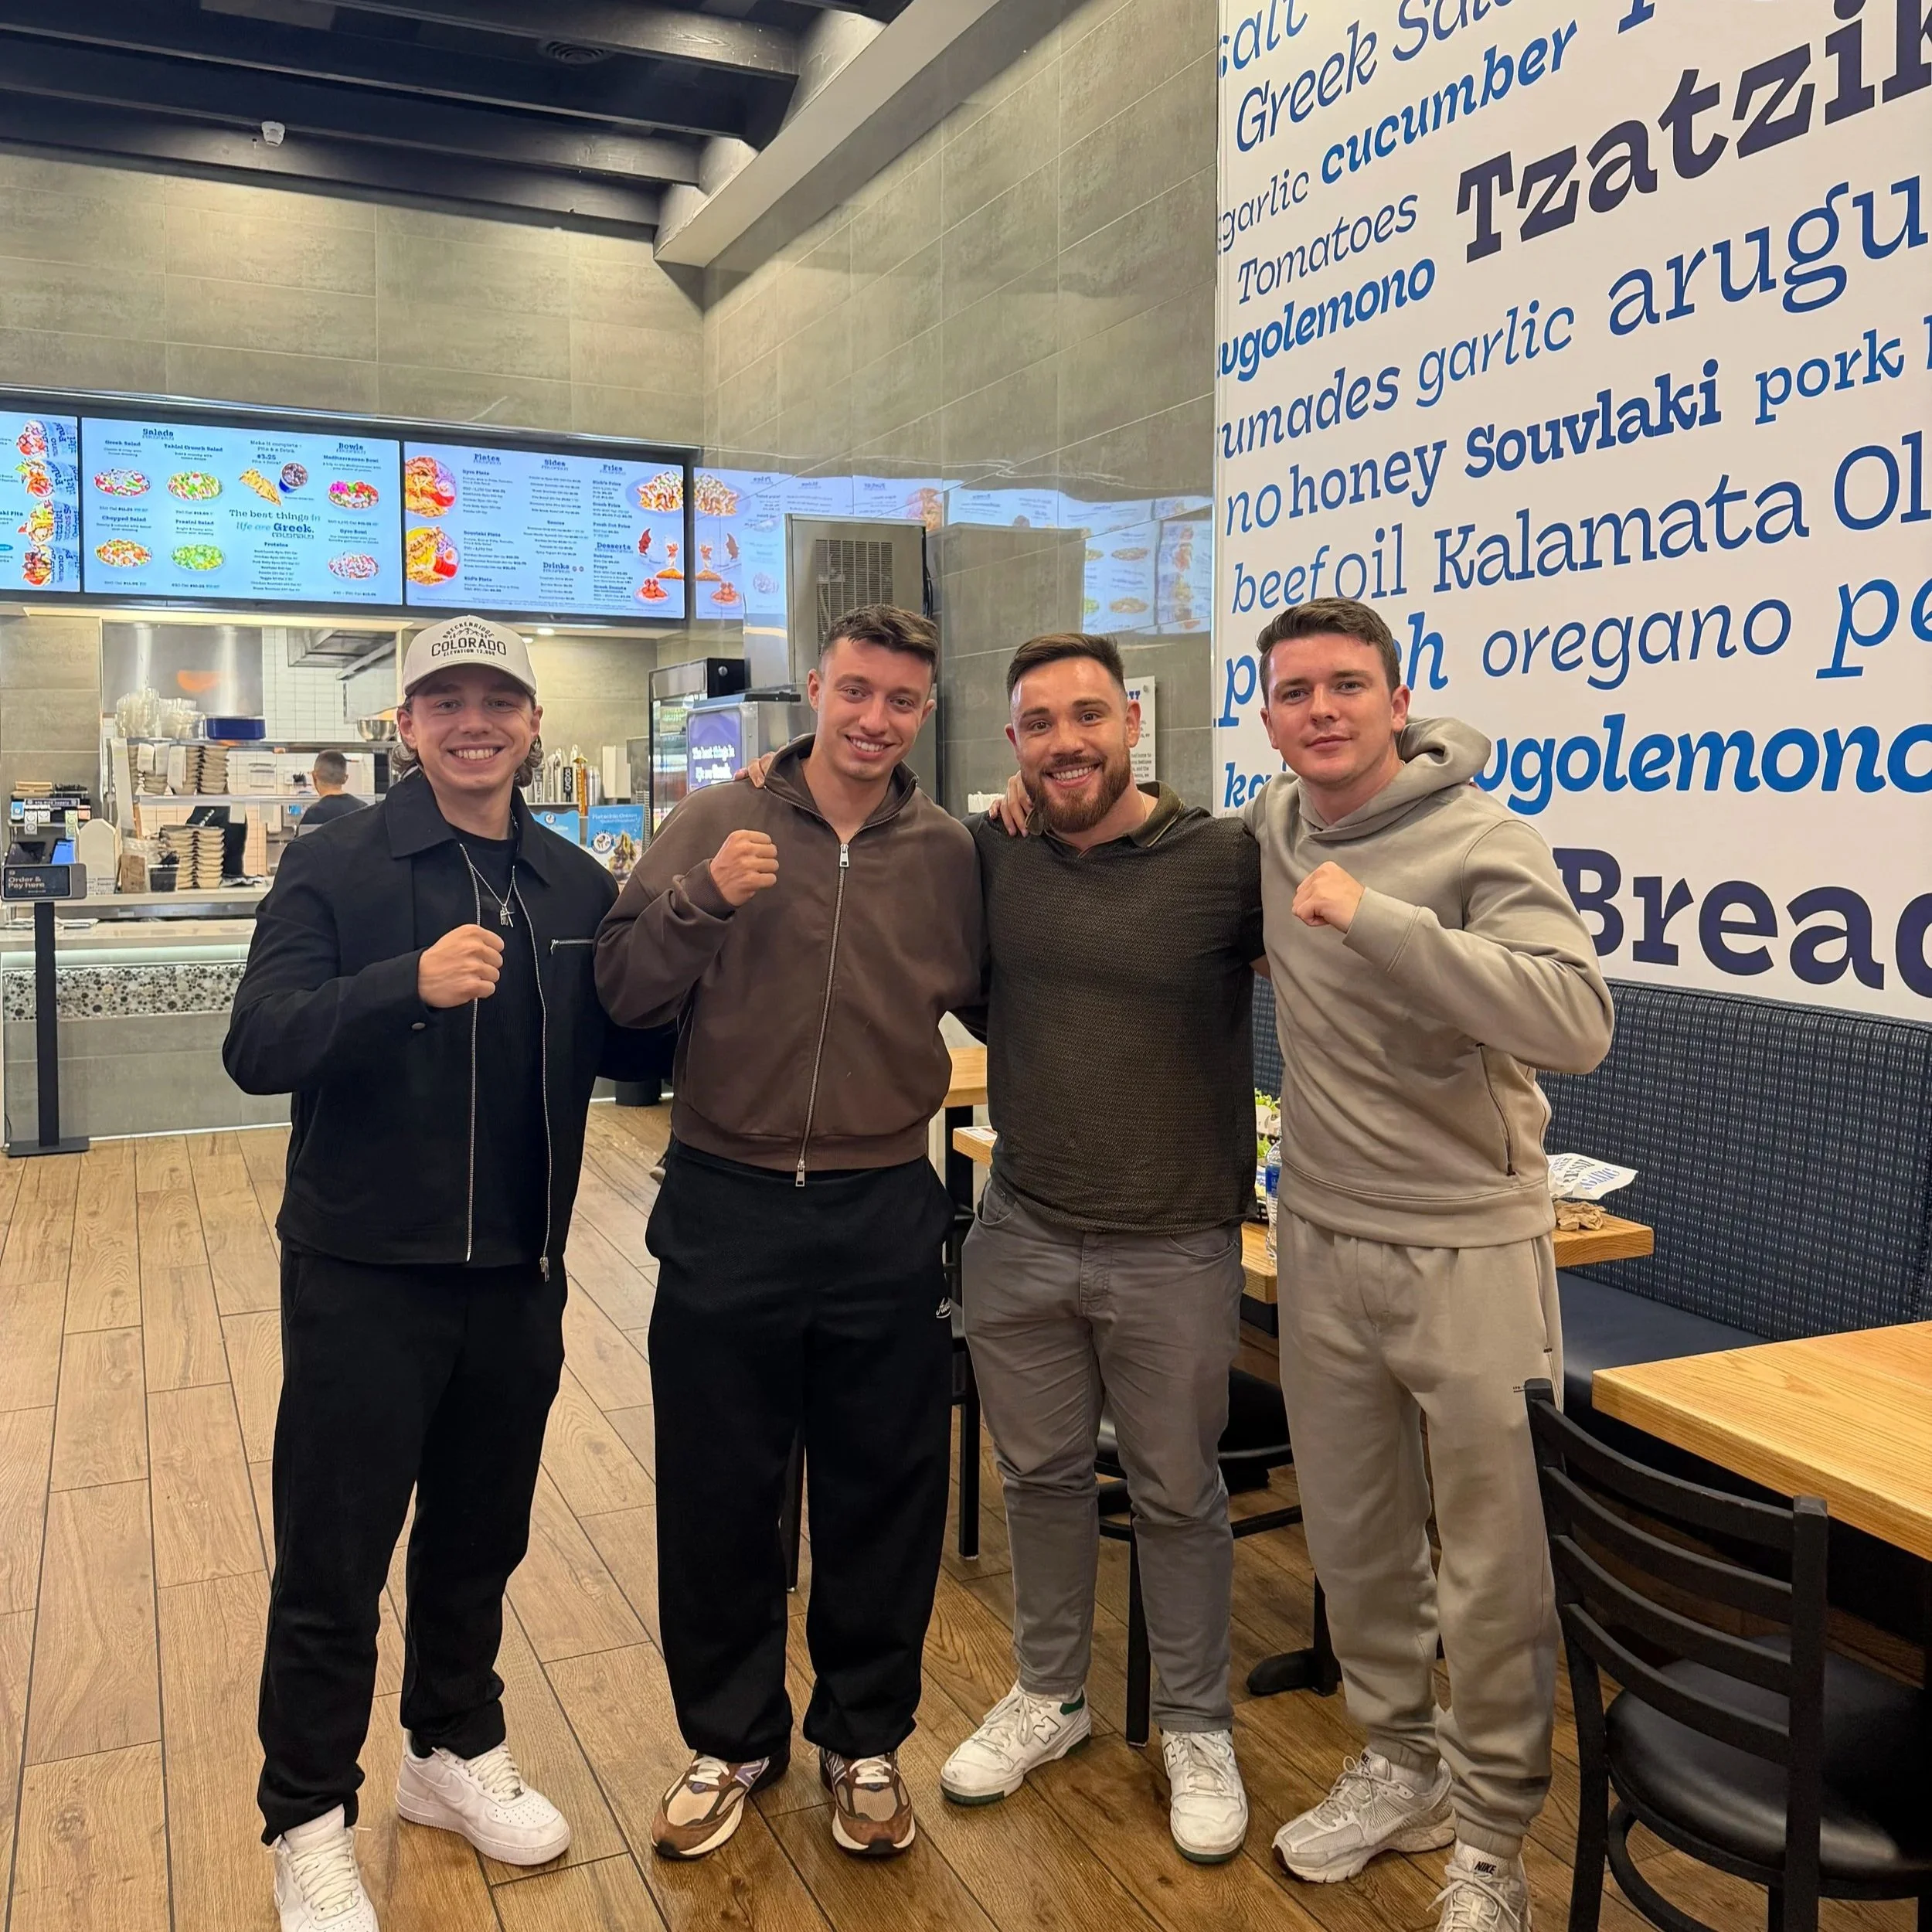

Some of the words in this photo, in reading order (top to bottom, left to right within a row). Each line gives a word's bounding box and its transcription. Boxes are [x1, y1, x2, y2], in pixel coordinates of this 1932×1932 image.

[1237, 21, 1377, 151] Greek
[1219, 168, 1309, 256] garlic
[1322, 20, 1577, 184] cucumber
[1238, 195, 1417, 304] Tomatoes
[1609, 175, 1928, 335] arugu
[1217, 367, 1400, 458] umades
[1417, 301, 1573, 406] garlic
[1227, 485, 1281, 536] no
[1290, 440, 1447, 518] honey
[1465, 359, 1721, 478] Souvlaki
[1755, 329, 1904, 424] pork
[338, 442, 363, 451] Bowls
[474, 454, 500, 462] Plates
[229, 509, 247, 518] The
[250, 510, 273, 519] best
[276, 512, 309, 522] things
[1233, 546, 1330, 613] beef
[1335, 523, 1406, 600] oil
[1434, 474, 1809, 592] Kalamata
[1835, 430, 1932, 530] Ol
[236, 522, 252, 531] life
[274, 522, 315, 533] Greek.
[597, 542, 631, 550] Desserts
[543, 561, 570, 570] Drinks
[443, 622, 495, 638] BRECKENRIDGE
[431, 638, 507, 657] COLORADO
[444, 648, 474, 657] ELEVATION
[1483, 600, 1791, 690] oregano
[1475, 1861, 1497, 1876] NIKE
